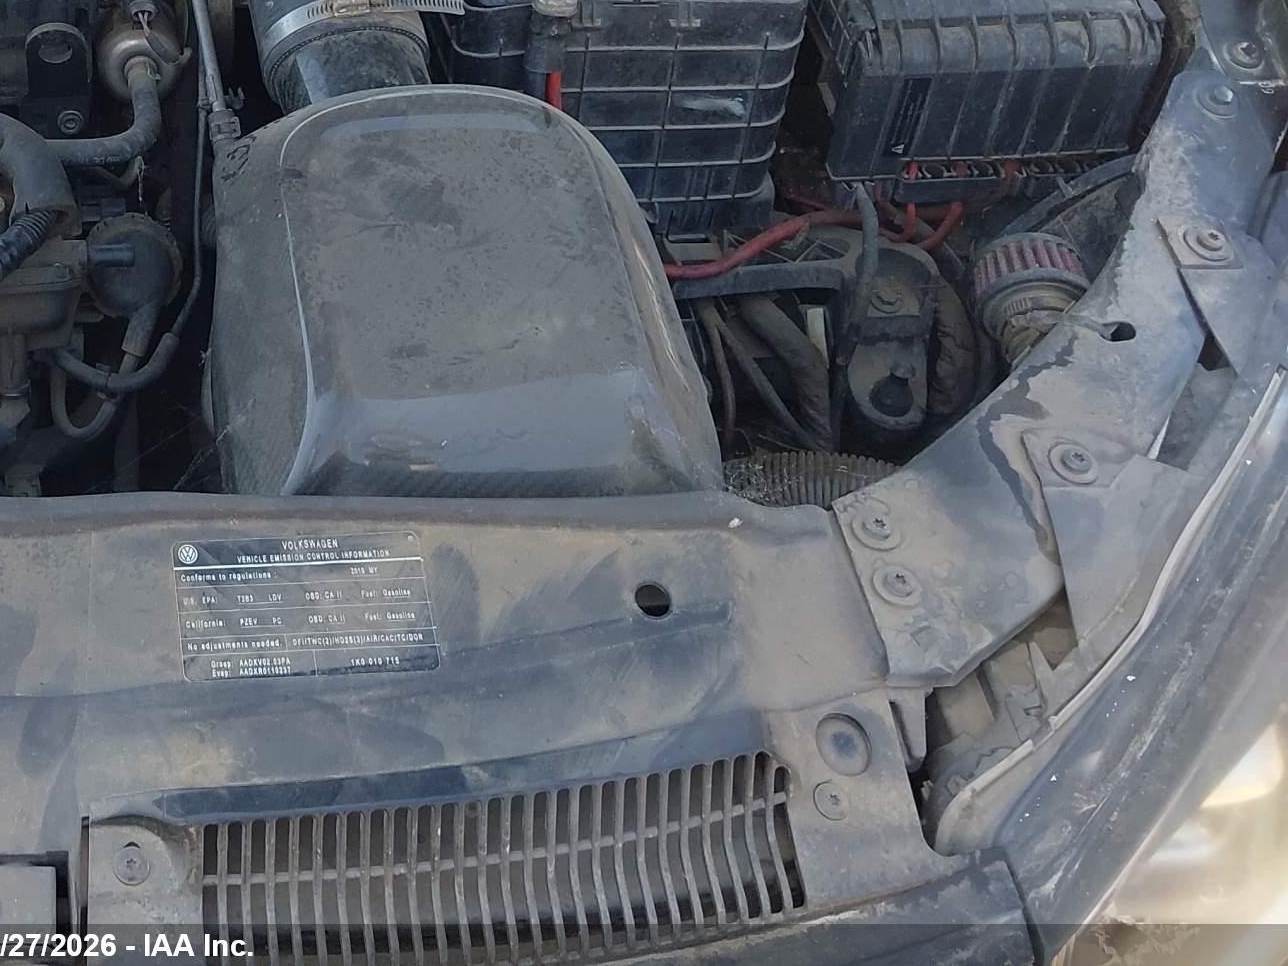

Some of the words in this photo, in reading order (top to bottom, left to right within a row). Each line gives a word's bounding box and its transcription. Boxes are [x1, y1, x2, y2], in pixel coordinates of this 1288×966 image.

[281, 539, 339, 550] VOLKSWAGEN
[237, 555, 267, 564] VEHICLE
[270, 554, 305, 563] EMISSION
[307, 551, 340, 561] CONTROL
[341, 549, 391, 560] INFORMATION
[181, 574, 216, 583] Conforms
[219, 573, 227, 581] to
[229, 571, 271, 581] regulations
[268, 594, 282, 602] LDV
[186, 619, 226, 629] California:
[187, 642, 198, 651] No
[201, 640, 248, 651] adjustments
